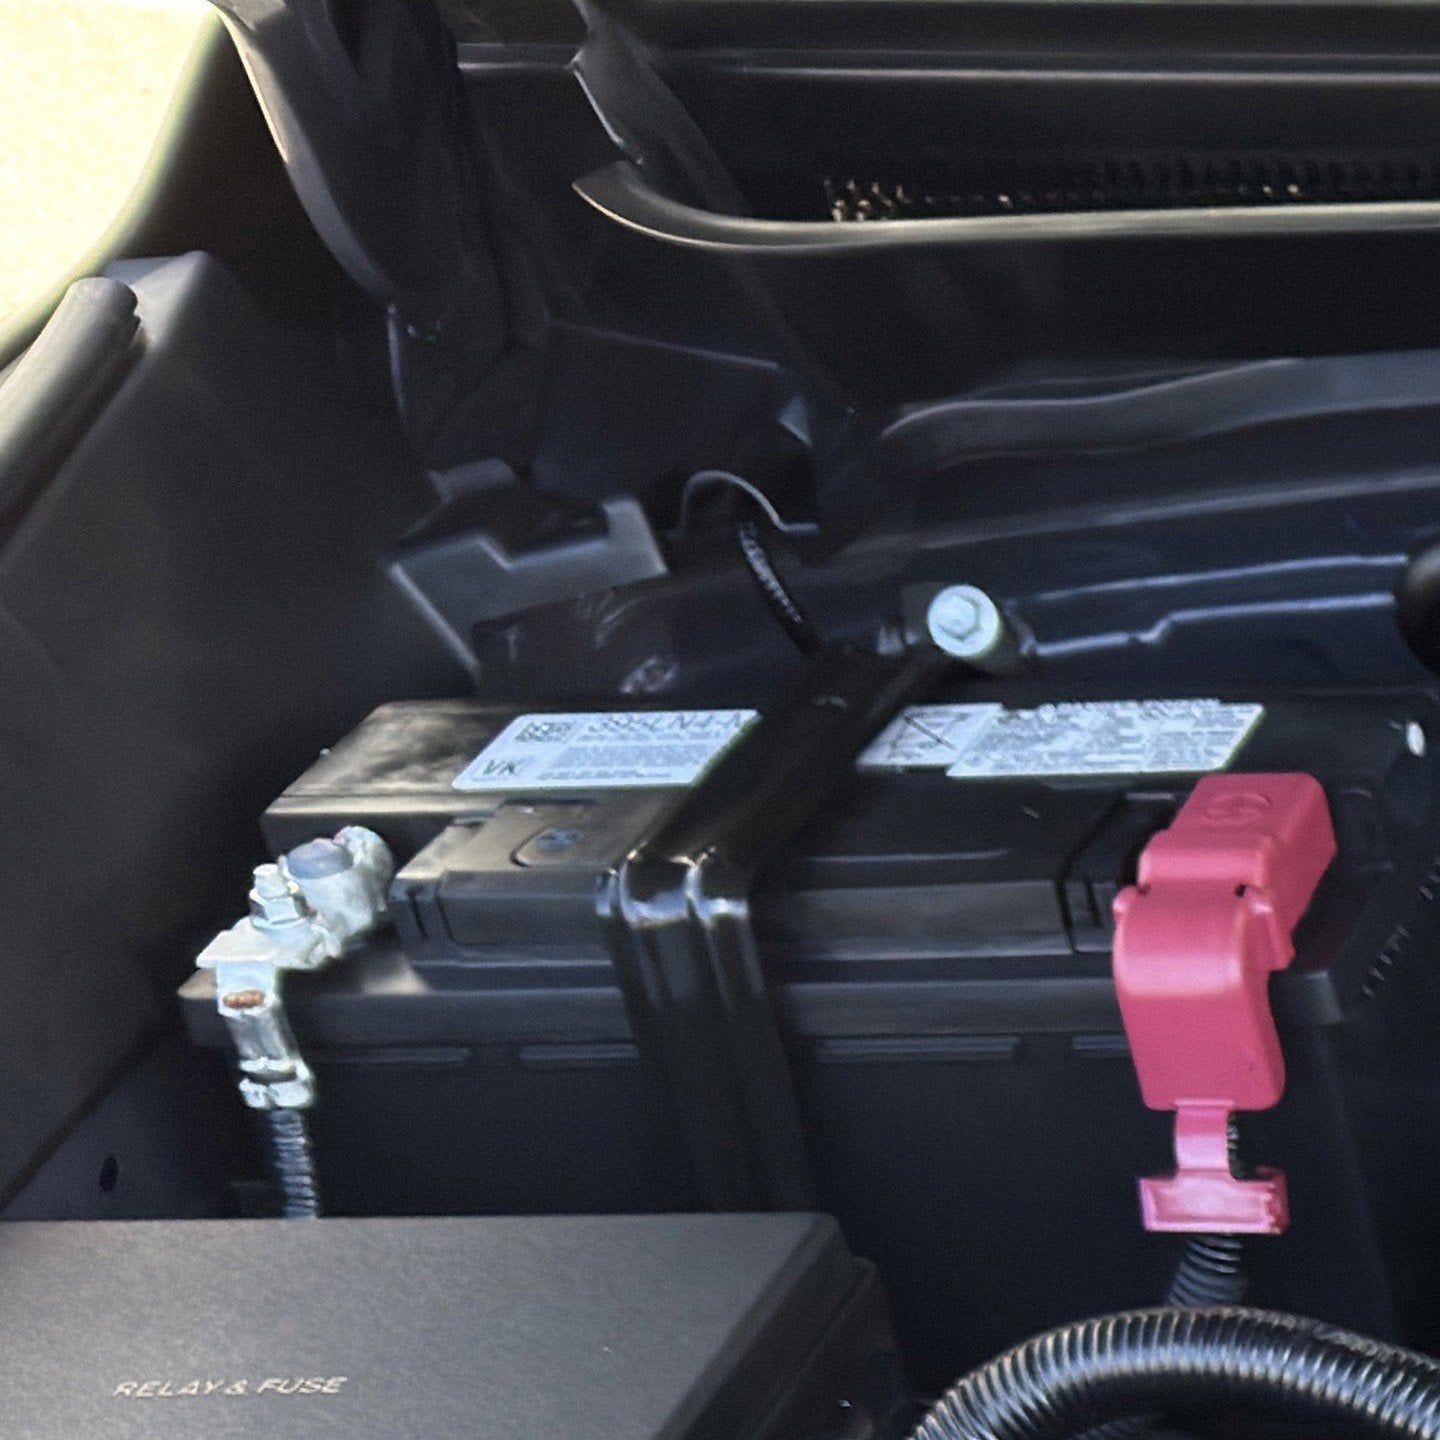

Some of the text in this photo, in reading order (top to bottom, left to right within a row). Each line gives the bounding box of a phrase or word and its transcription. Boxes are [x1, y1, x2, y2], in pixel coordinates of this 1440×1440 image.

[113, 1375, 348, 1397] RELAY & FUSE
